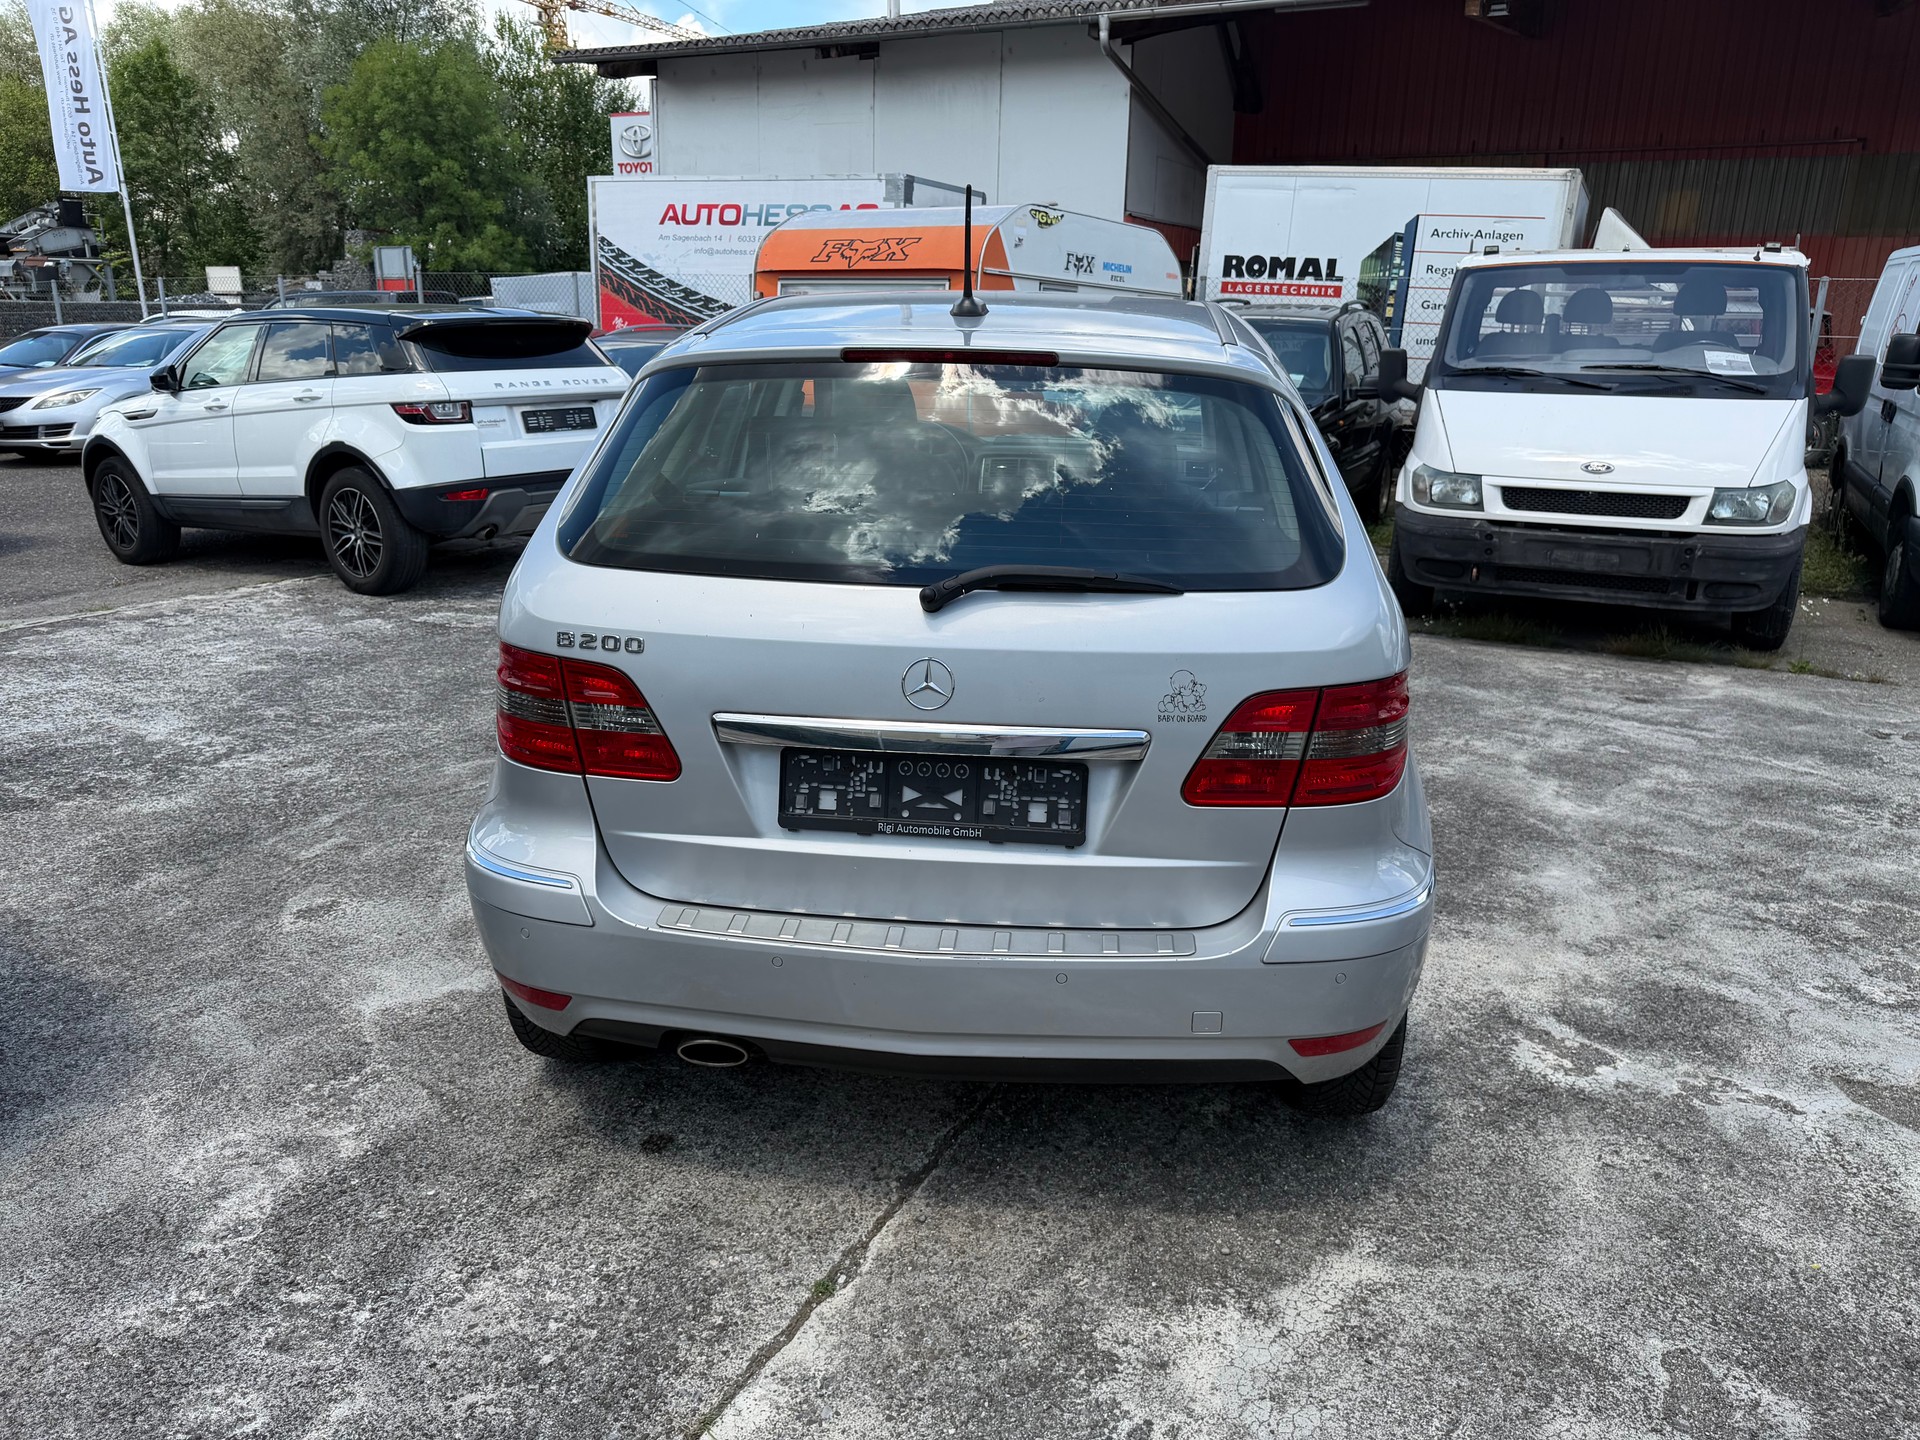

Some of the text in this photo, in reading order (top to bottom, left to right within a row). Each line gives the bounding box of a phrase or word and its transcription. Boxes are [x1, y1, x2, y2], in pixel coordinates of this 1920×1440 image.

[618, 161, 653, 174] TOYOT
[714, 234, 723, 242] 14
[737, 235, 756, 243] 6033
[1430, 228, 1524, 243] Archiv-Anlagen
[1103, 262, 1132, 274] MICHELIN
[1222, 254, 1343, 282] ROMAL
[1426, 264, 1454, 278] Rega
[1227, 284, 1335, 296] LAGERTECHNIK
[493, 378, 609, 389] RANGE ROVER
[1157, 714, 1207, 723] BABY ON BOARD
[877, 822, 982, 838] Rigi Automobile GmbH
